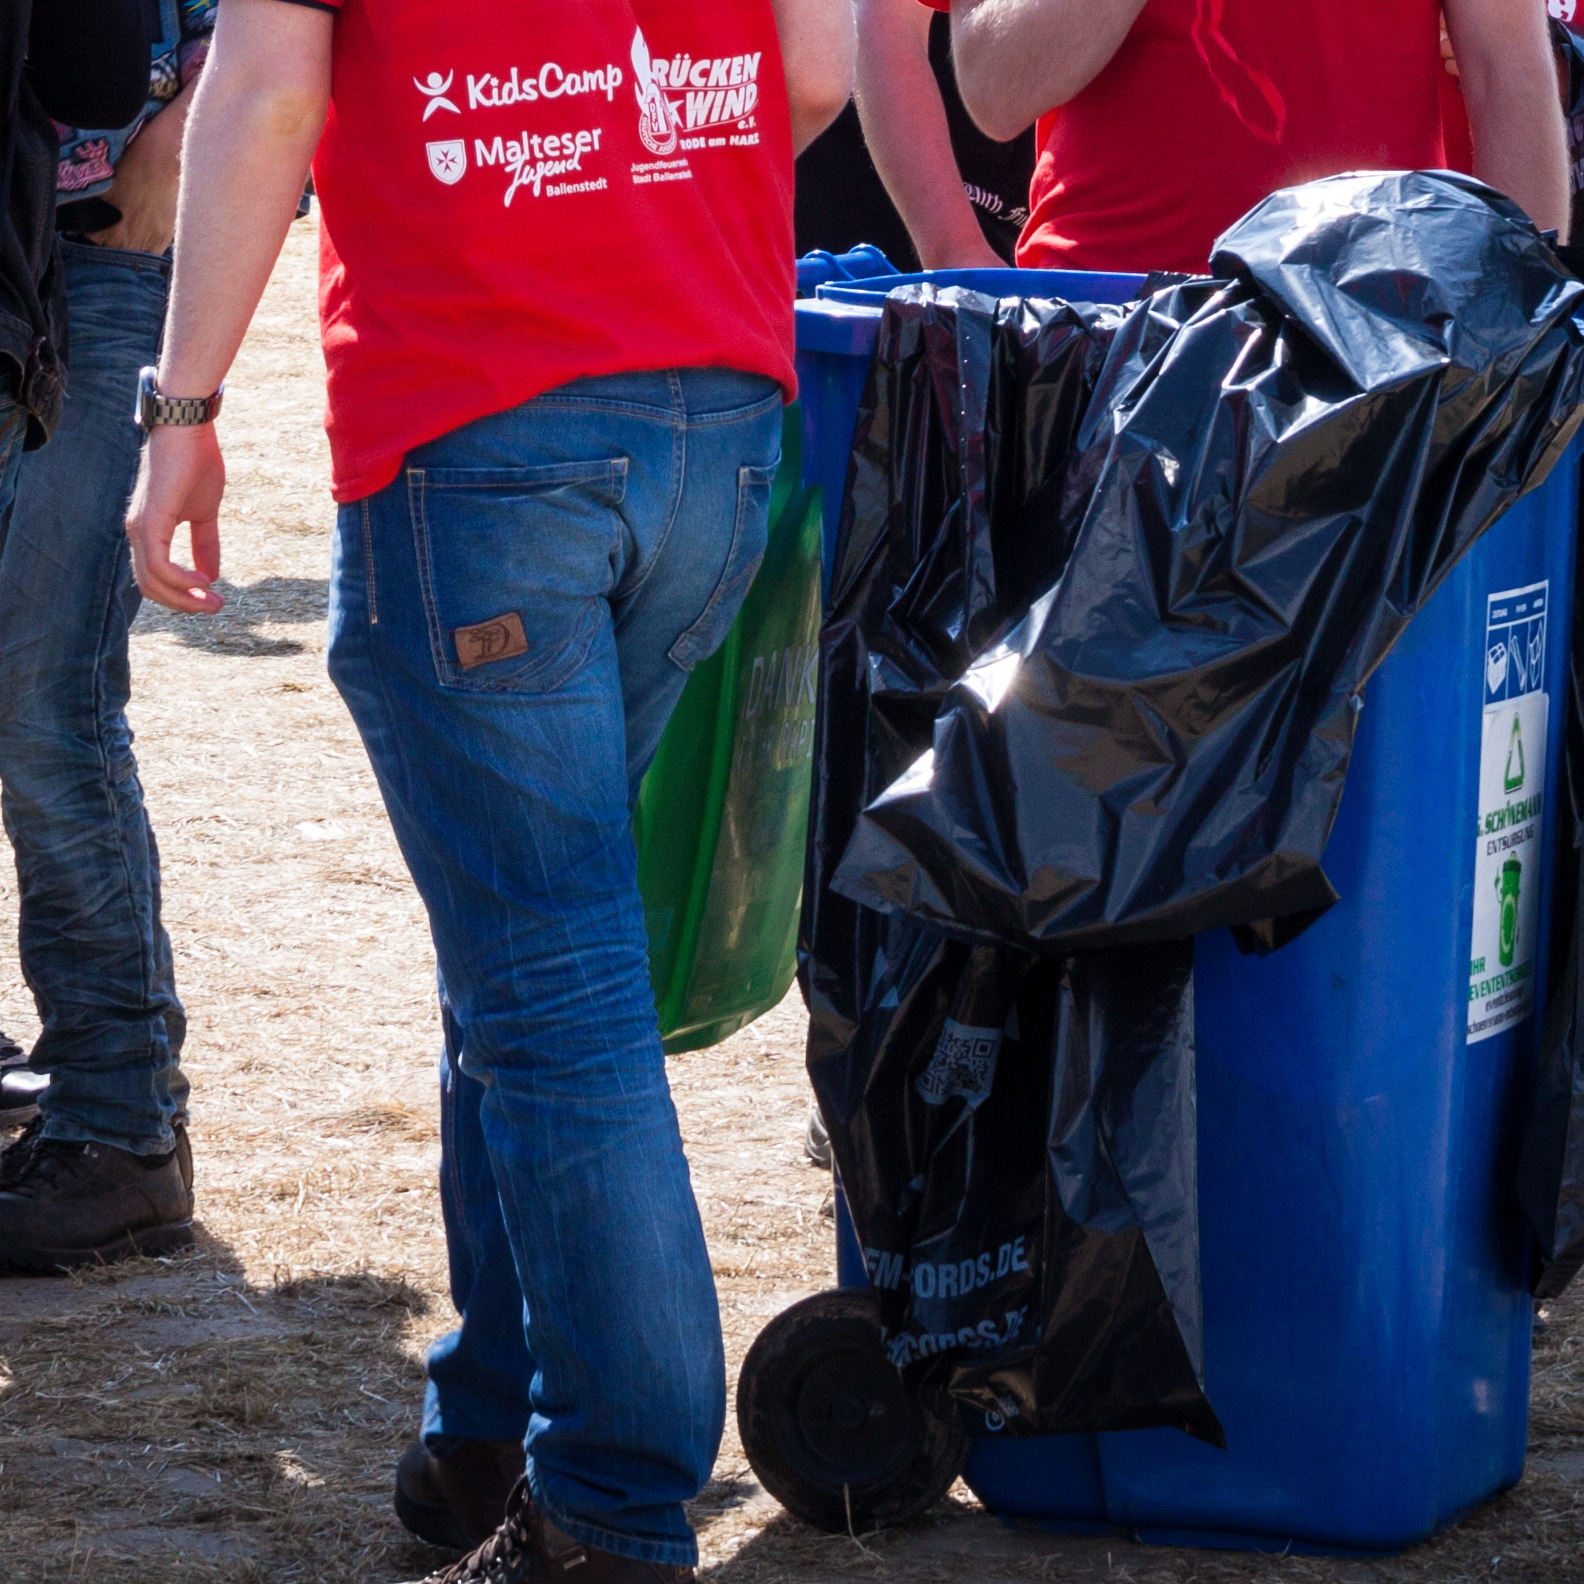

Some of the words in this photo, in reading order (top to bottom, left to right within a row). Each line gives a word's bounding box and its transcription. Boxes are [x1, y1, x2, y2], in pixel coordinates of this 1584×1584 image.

[650, 52, 762, 87] RÜCKEN
[685, 82, 757, 130] WIND
[474, 128, 602, 167] Malteser
[504, 143, 582, 208] Jugend
[545, 177, 609, 197] Ballenstedt
